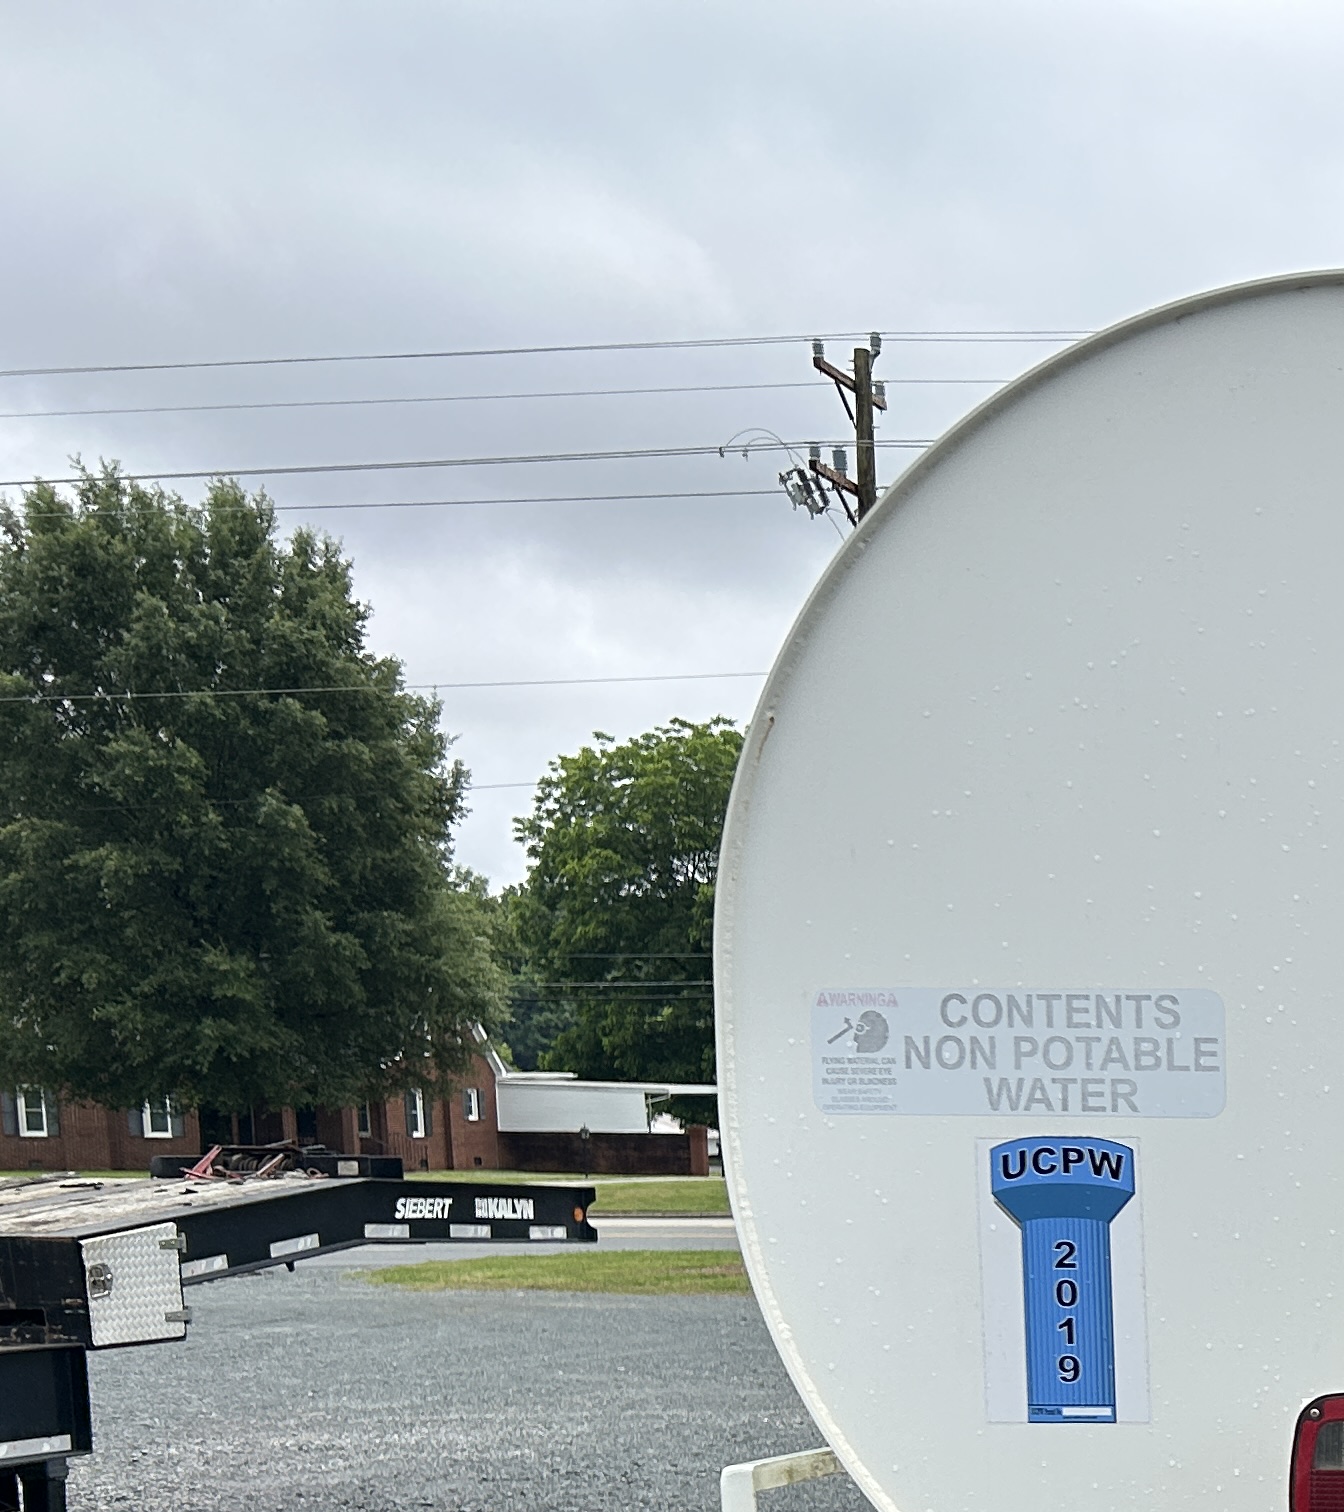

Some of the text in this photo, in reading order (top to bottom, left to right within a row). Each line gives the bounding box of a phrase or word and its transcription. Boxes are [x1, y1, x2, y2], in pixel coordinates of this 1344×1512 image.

[828, 992, 887, 1007] WARNING
[940, 993, 1181, 1030] CONTENTS
[904, 1035, 1220, 1073] NON POTABLE
[983, 1077, 1141, 1113] WATER
[1001, 1147, 1124, 1181] UCPW
[394, 1197, 453, 1220] SIEBERT
[1054, 1241, 1081, 1383] 2019
